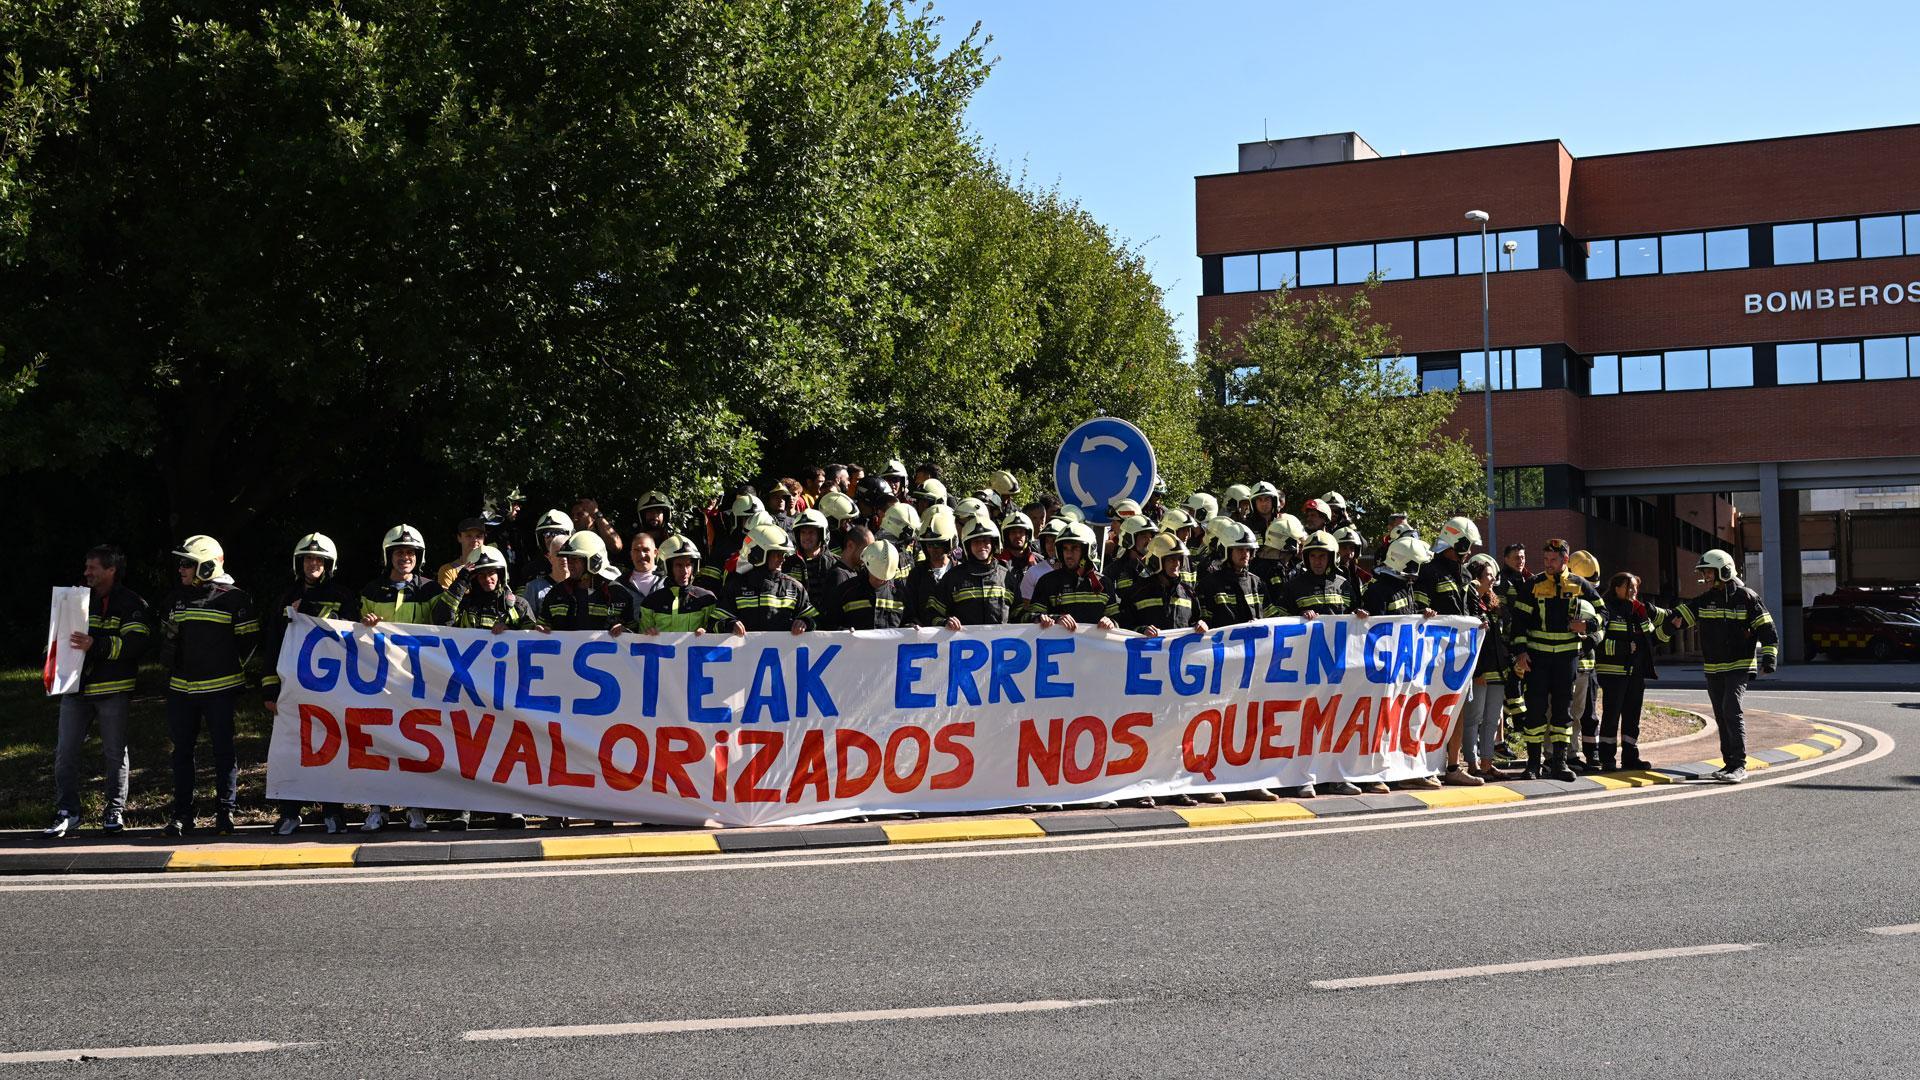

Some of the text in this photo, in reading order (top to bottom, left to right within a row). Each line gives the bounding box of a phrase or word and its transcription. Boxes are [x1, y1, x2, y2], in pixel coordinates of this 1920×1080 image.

[1744, 281, 1920, 314] BOMBEROS
[894, 636, 1077, 710] ERRE
[1016, 711, 1154, 788] NOS
